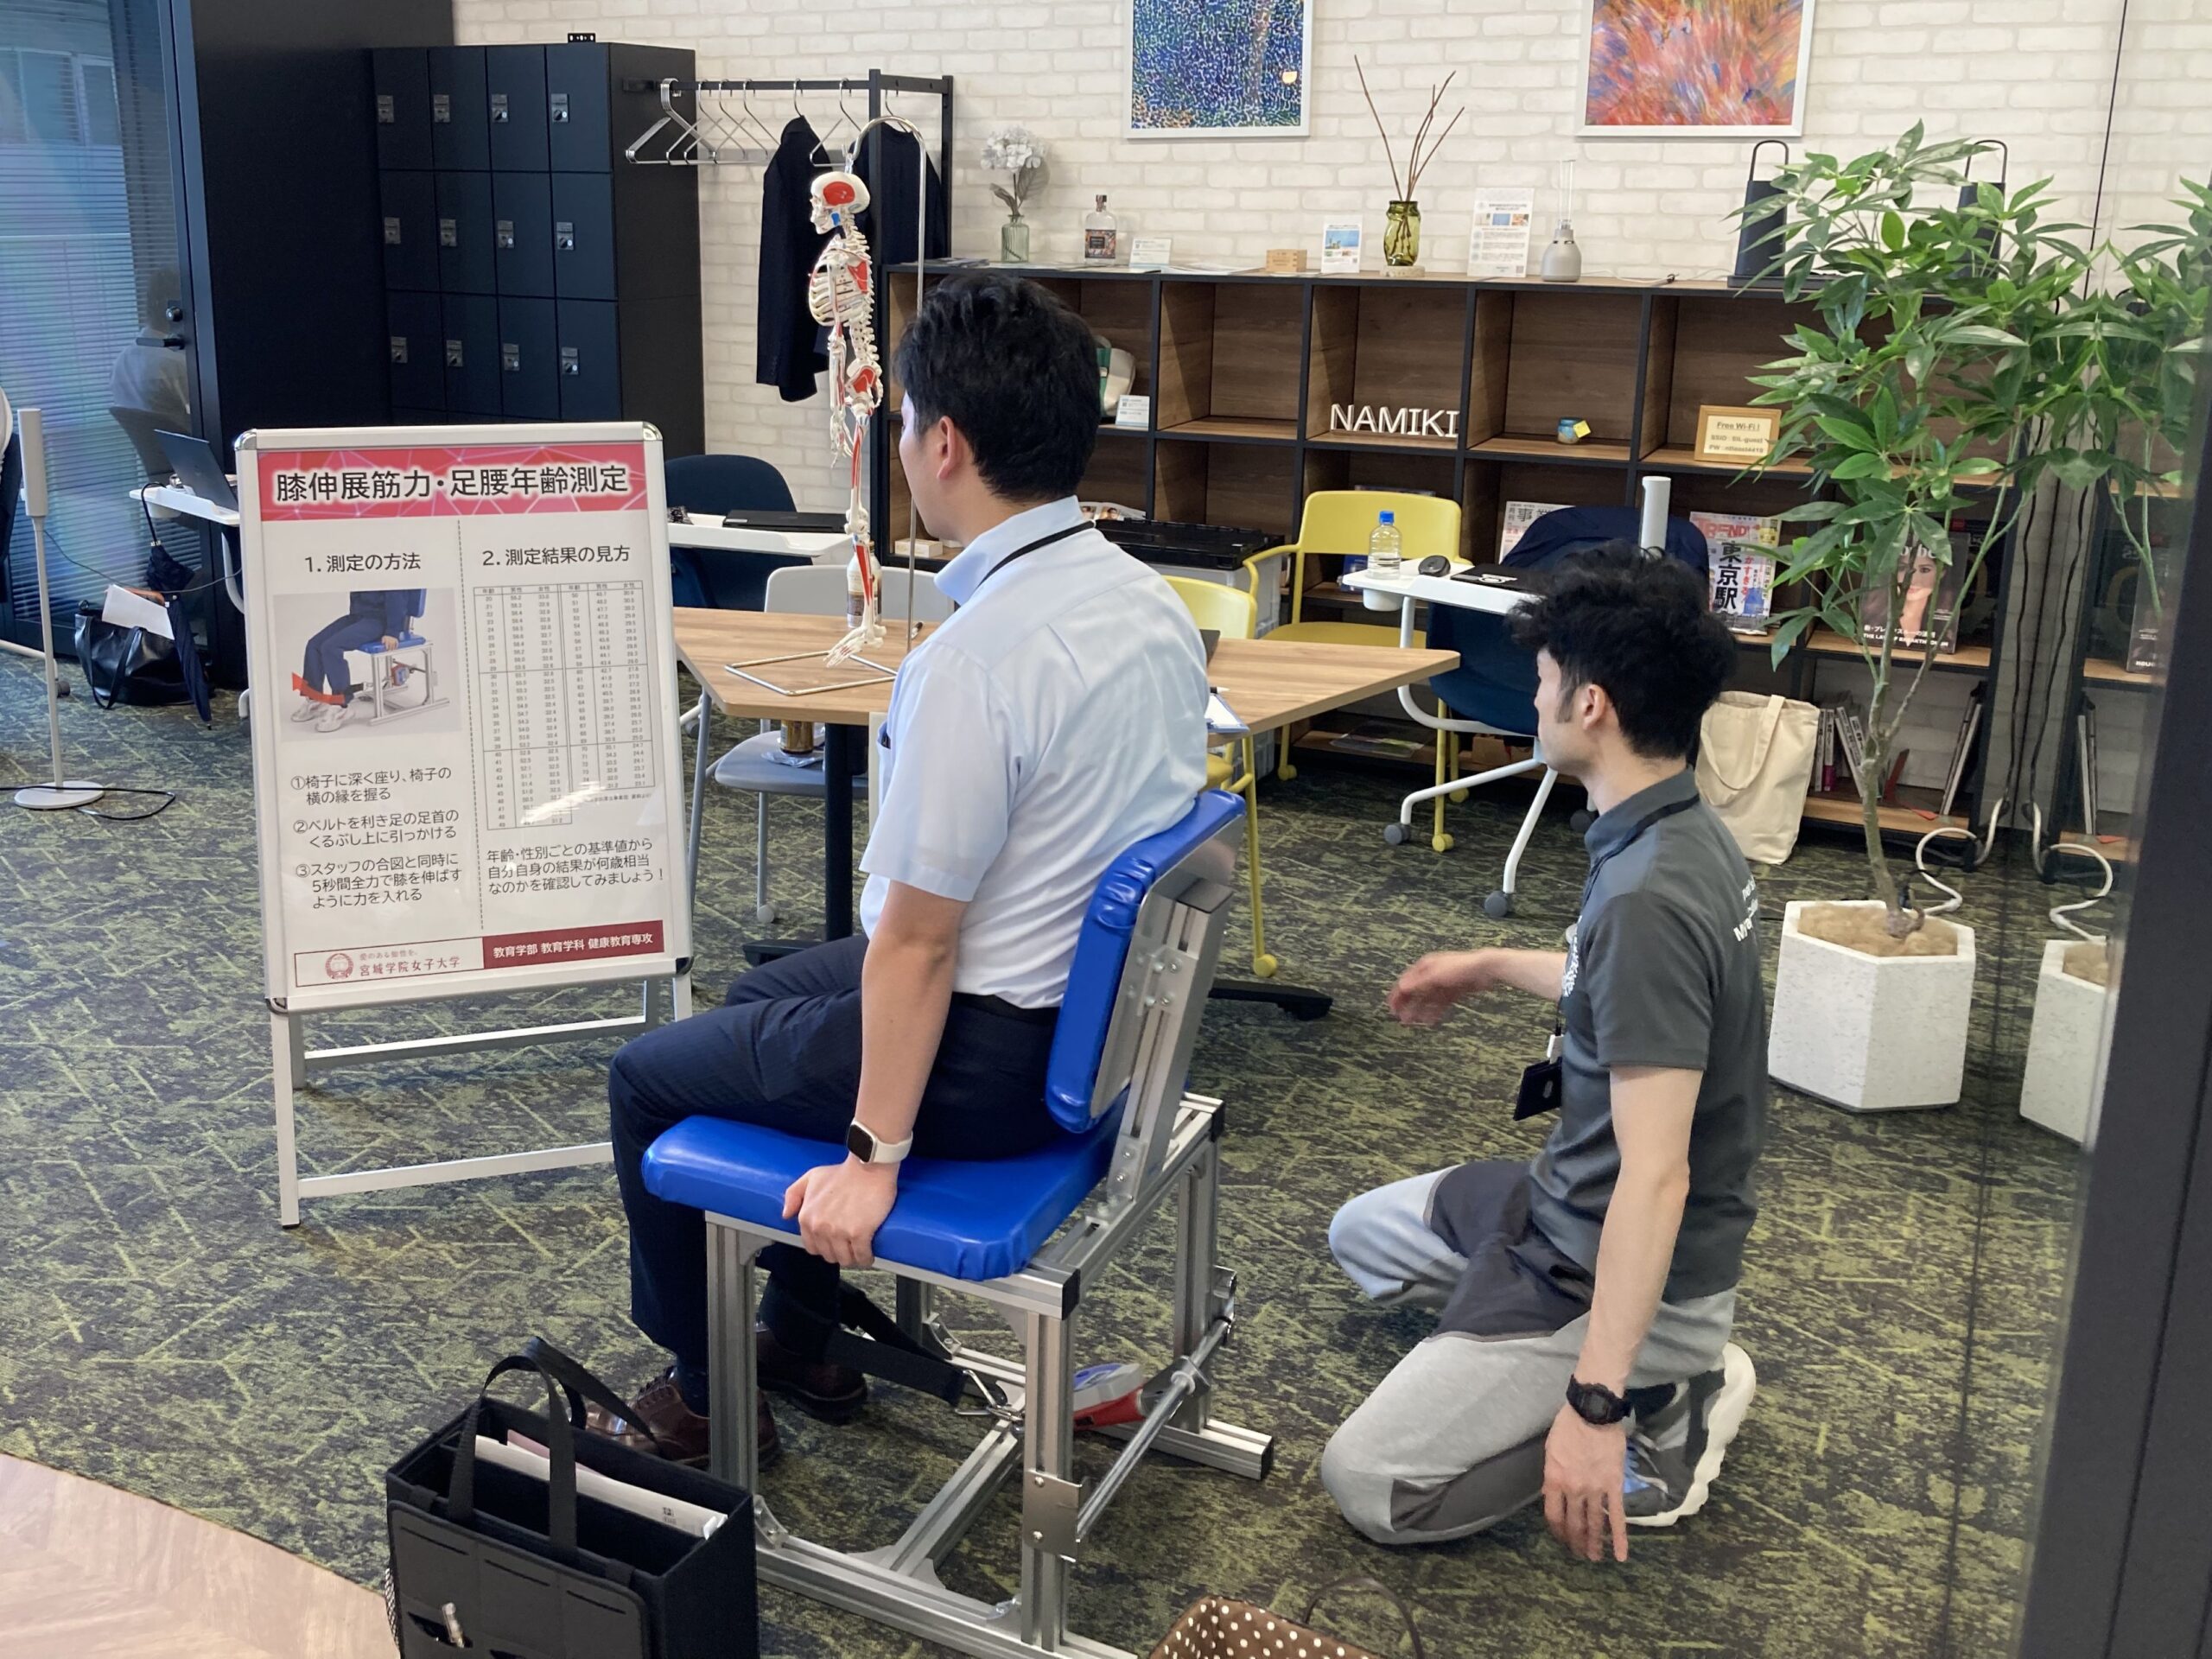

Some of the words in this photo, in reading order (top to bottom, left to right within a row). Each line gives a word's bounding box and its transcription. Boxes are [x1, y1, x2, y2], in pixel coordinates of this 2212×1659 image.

[1330, 404, 1460, 438] NAMIKI
[276, 465, 629, 502] 膝伸展筋力・足腰年齢測定
[1715, 540, 1742, 610] 東京駅
[306, 787, 391, 805] 横の縁を握る
[310, 826, 456, 849] くるぶし上に引っかける
[487, 838, 652, 861] 年齢・性別ごとの基準値から
[488, 855, 650, 879] 自分自身の結果が何歳相当
[312, 868, 462, 892] 5秒間全力で膝を伸ばす
[312, 889, 422, 909] ように力を入れる
[493, 944, 538, 959] 教育学部
[541, 938, 585, 954] 教育学科
[588, 932, 653, 950] 健康教育専攻
[359, 956, 460, 977] 宮城学院女子大学
